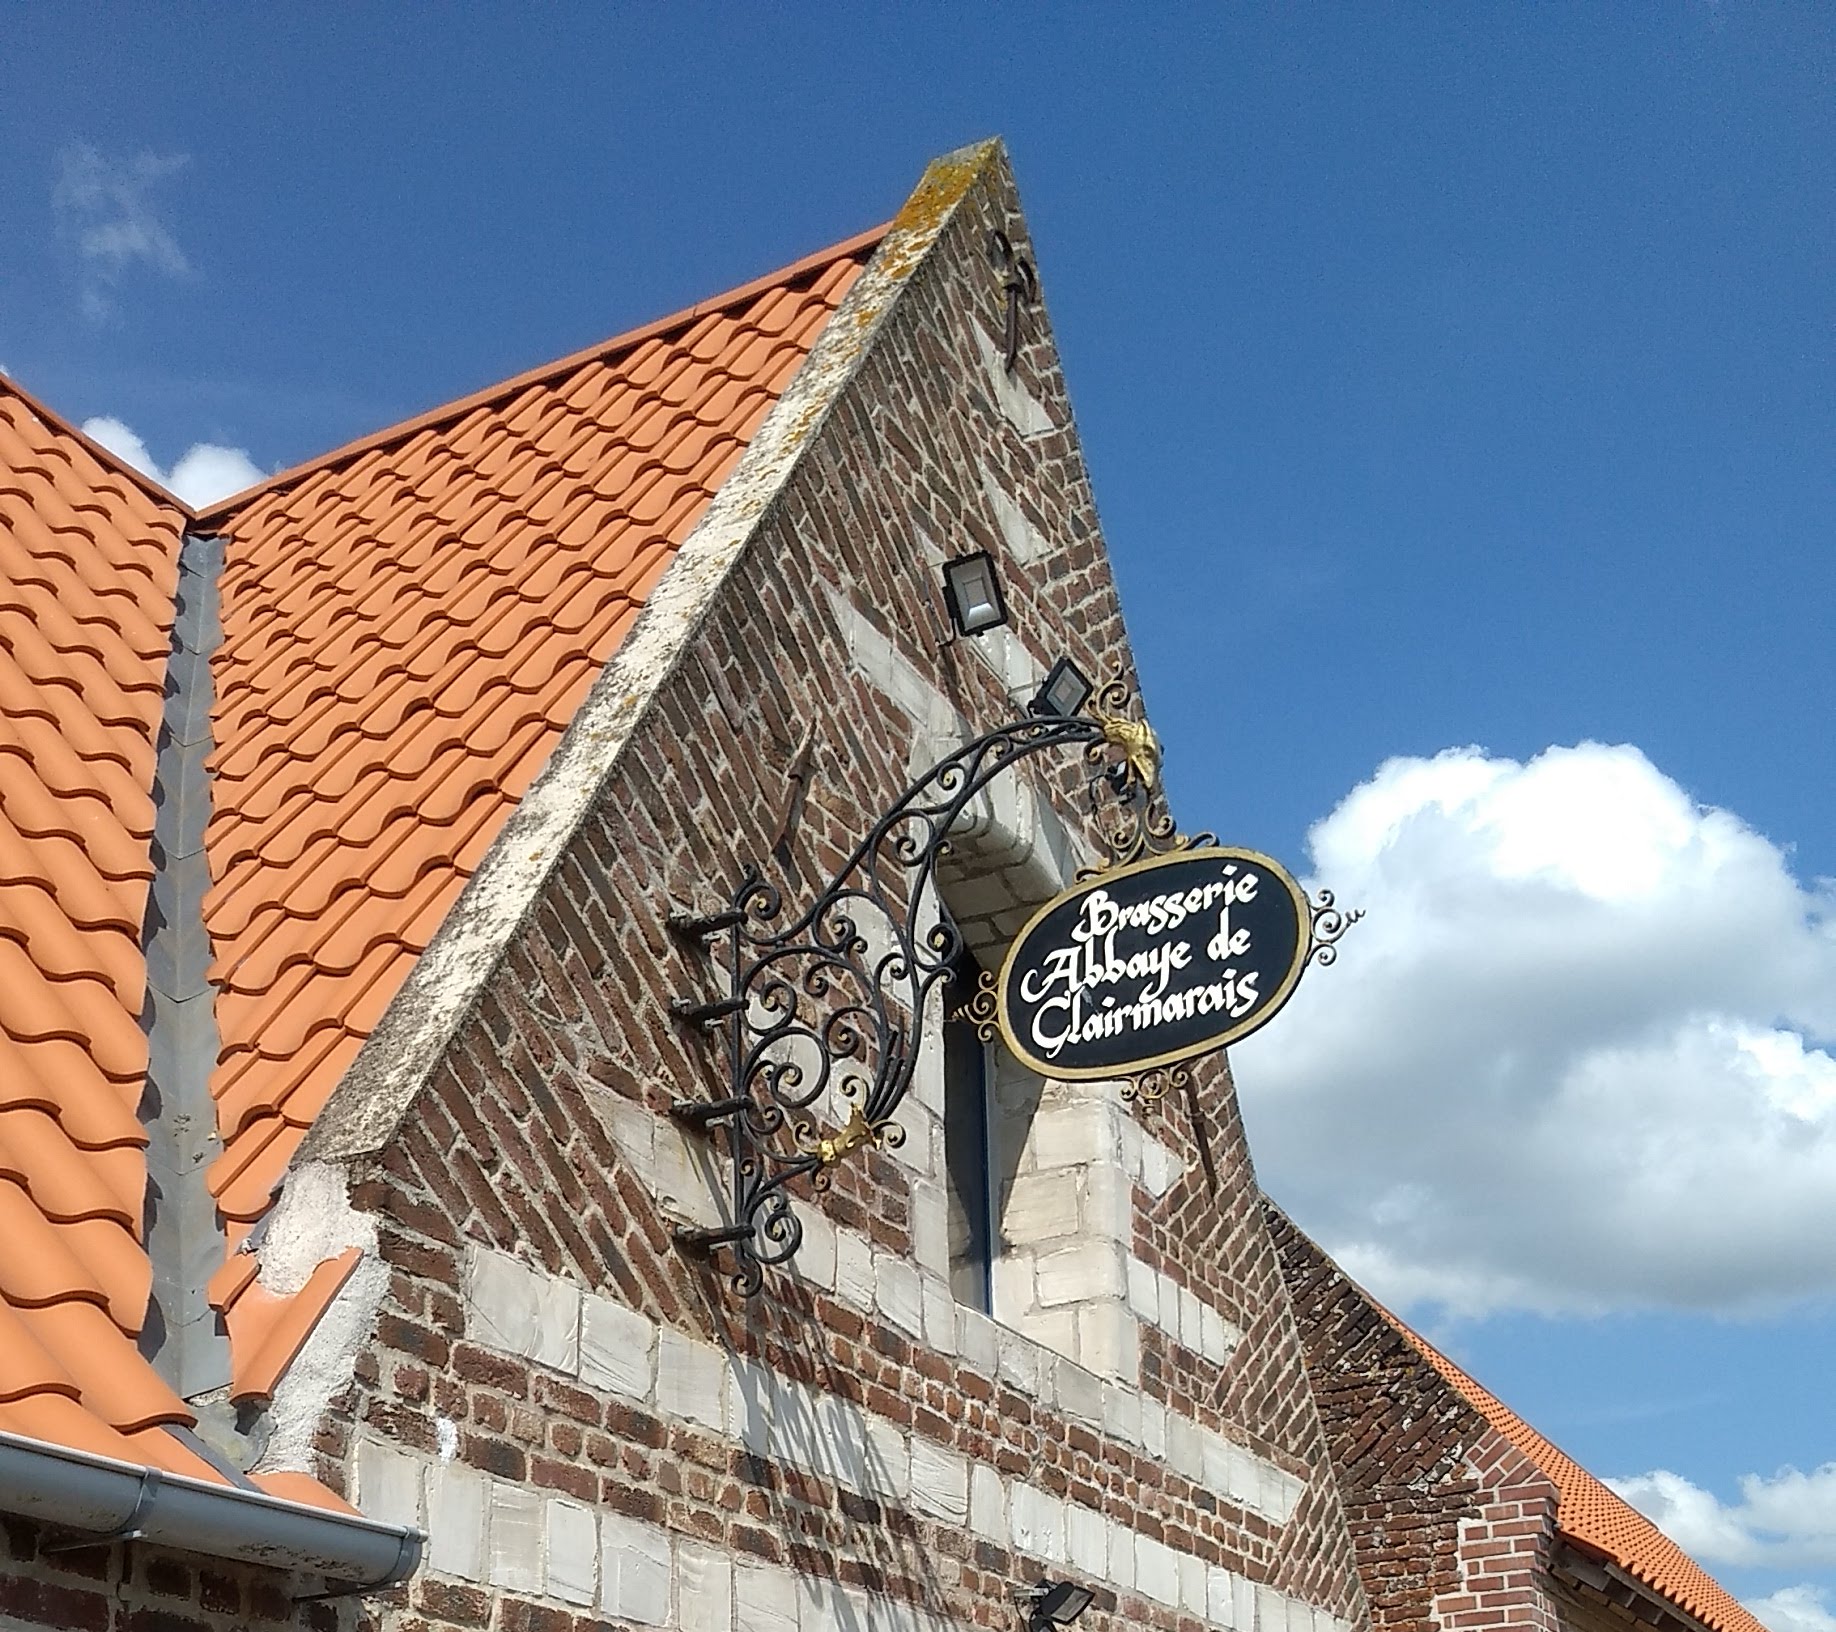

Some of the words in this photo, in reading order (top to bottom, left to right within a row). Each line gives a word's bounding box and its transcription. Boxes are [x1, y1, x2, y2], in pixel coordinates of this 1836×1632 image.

[1071, 864, 1259, 942] Brasserie
[1020, 925, 1193, 1005] Abbaye
[1206, 909, 1251, 962] de
[1031, 968, 1260, 1059] Clairmarais
